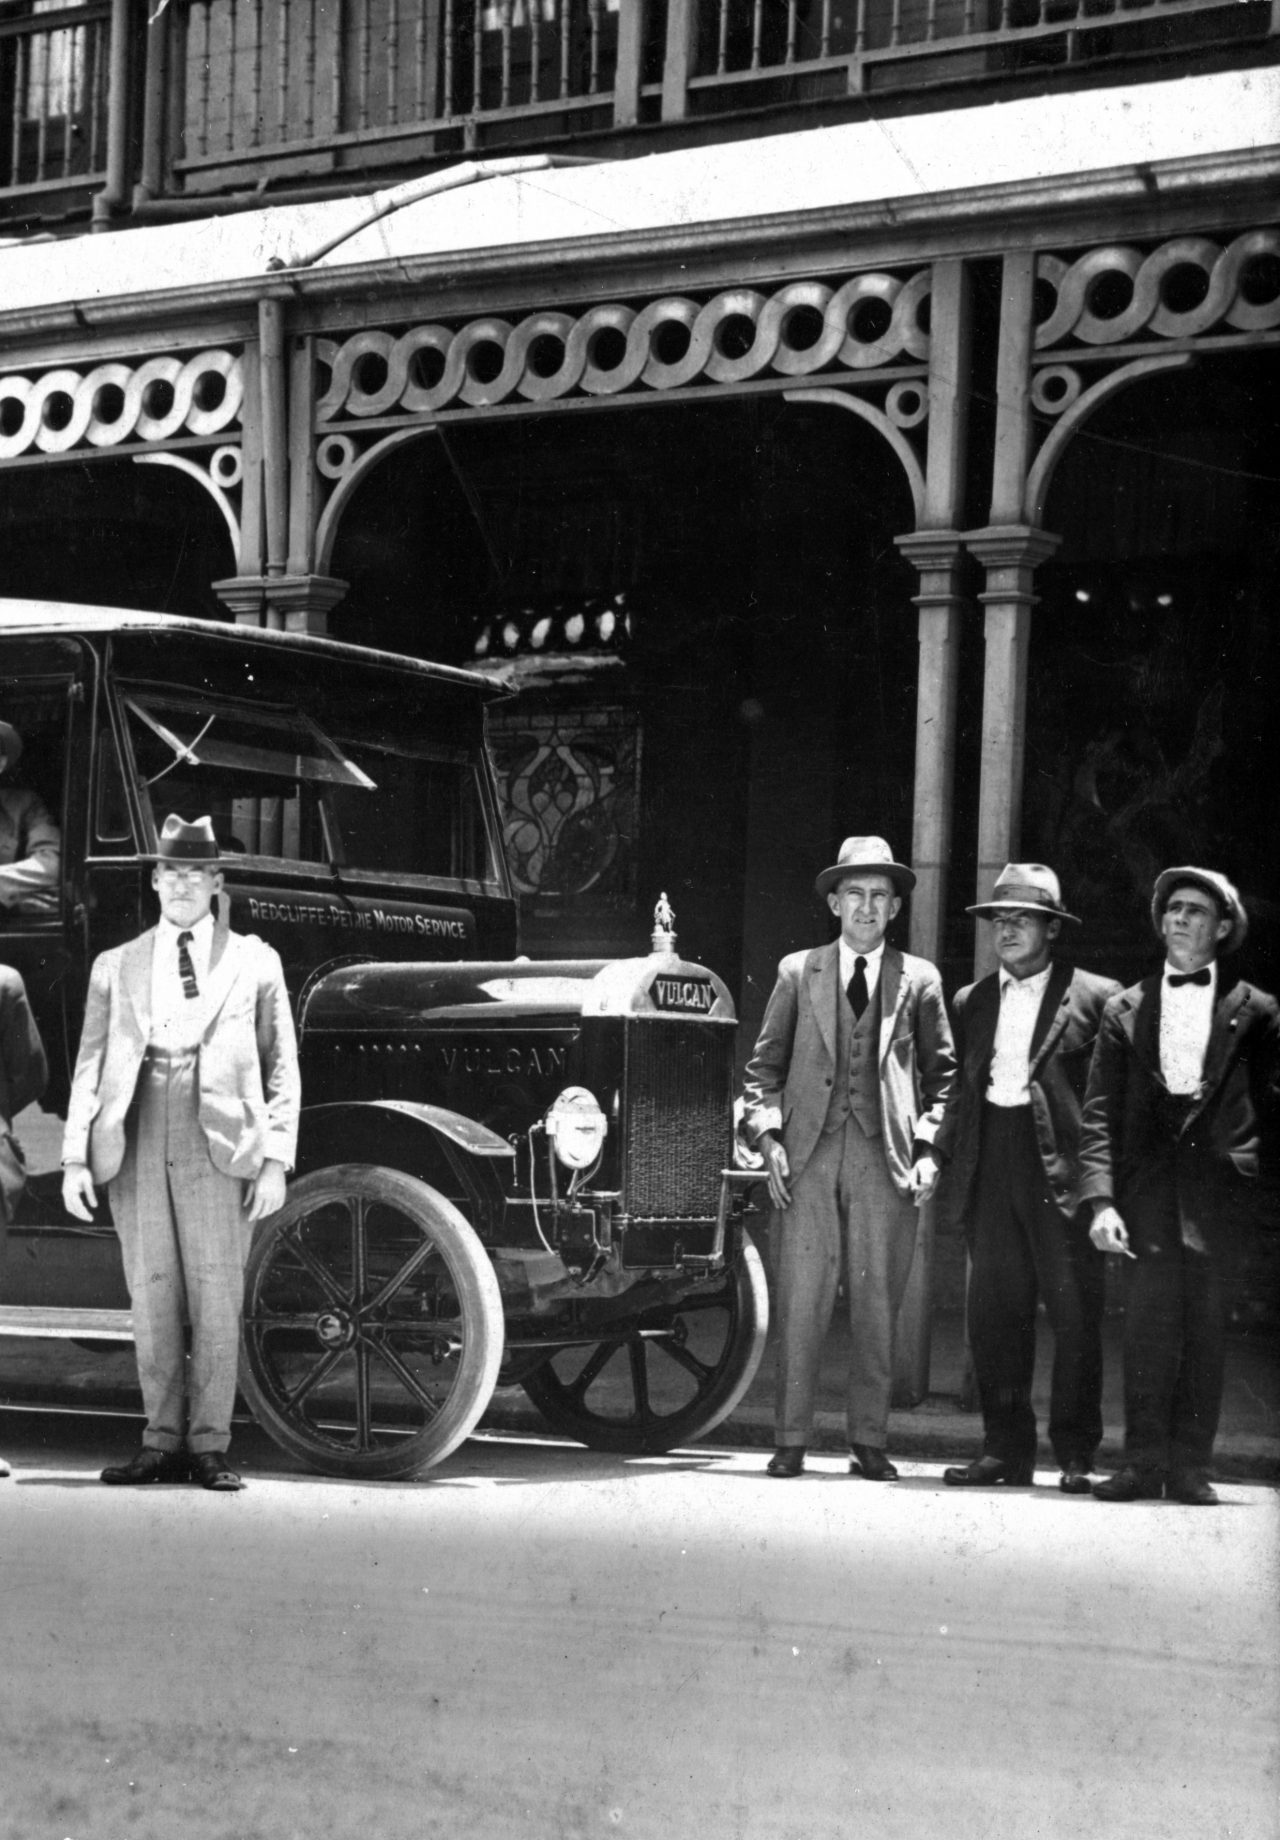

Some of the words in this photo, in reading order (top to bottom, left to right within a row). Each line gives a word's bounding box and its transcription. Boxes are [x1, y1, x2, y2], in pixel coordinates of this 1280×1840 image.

[373, 909, 415, 934] MOTOR
[415, 914, 467, 940] SERVICE
[654, 980, 712, 1009] VULCAN
[440, 1047, 568, 1077] VULCAN
